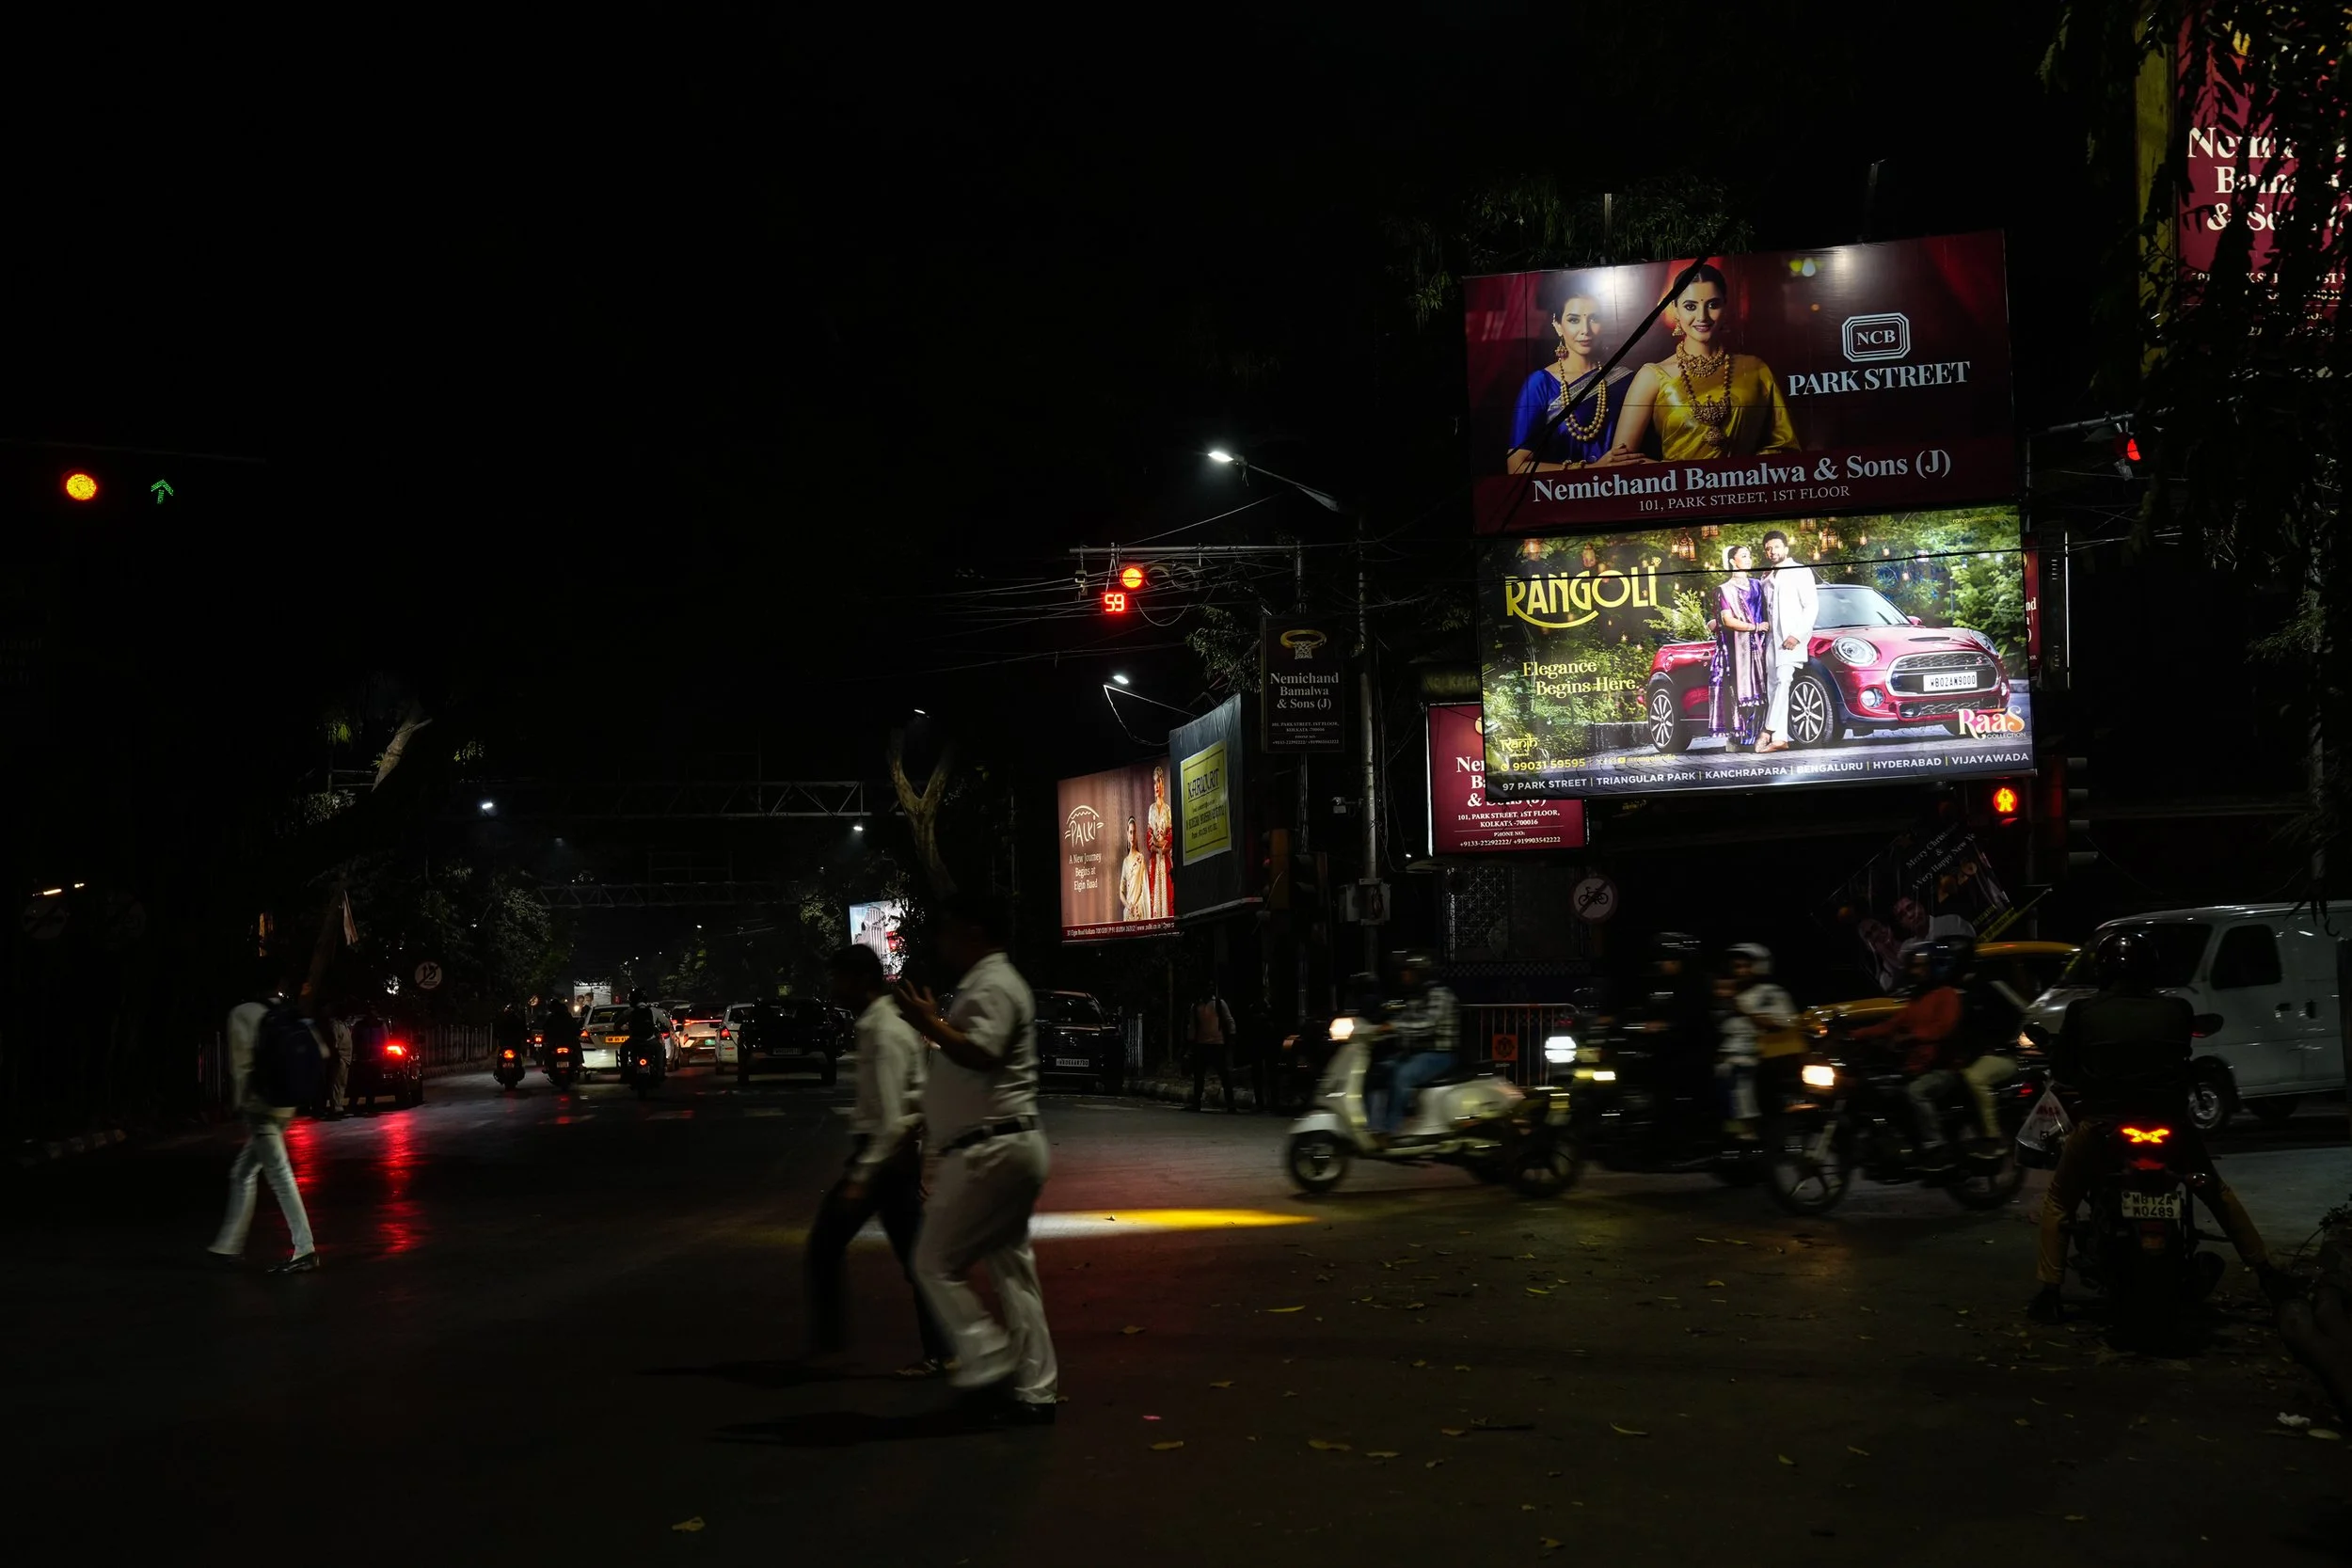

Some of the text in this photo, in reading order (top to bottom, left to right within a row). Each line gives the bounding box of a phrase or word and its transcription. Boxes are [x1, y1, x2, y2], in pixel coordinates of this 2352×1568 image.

[1855, 329, 1897, 346] NCB
[1788, 360, 1971, 397] PARK STREET
[1532, 449, 1952, 503] Nemichand Bamalwa & Sons (J)
[1639, 485, 1851, 512] 101, PARK STREET, 1ST FLOOR
[1104, 594, 1124, 612] 59
[1504, 565, 1658, 628] RANGOLI
[1270, 672, 1340, 685] Nemichand
[1523, 661, 1597, 679] Elegance
[1279, 686, 1329, 696] Bamalwa
[1535, 676, 1640, 699] Begins Here.
[1277, 698, 1332, 711] & Sons (J)
[1986, 731, 2026, 740] COLLECTION
[1502, 752, 2029, 792] 97 PARK STREET TRIANGULAR PARK KANCHRAPARA BENGALURU HYDERABAD VIJAYAWADA
[1513, 760, 1547, 771] 99031
[1549, 757, 1586, 768] 59595
[1467, 793, 1483, 807] &
[1073, 854, 1083, 863] New
[1084, 852, 1102, 864] Journey
[1905, 848, 1928, 870] Merry
[1931, 855, 1953, 874] Happy
[1074, 866, 1096, 879] Begins at
[1074, 879, 1098, 893] Elgin Road
